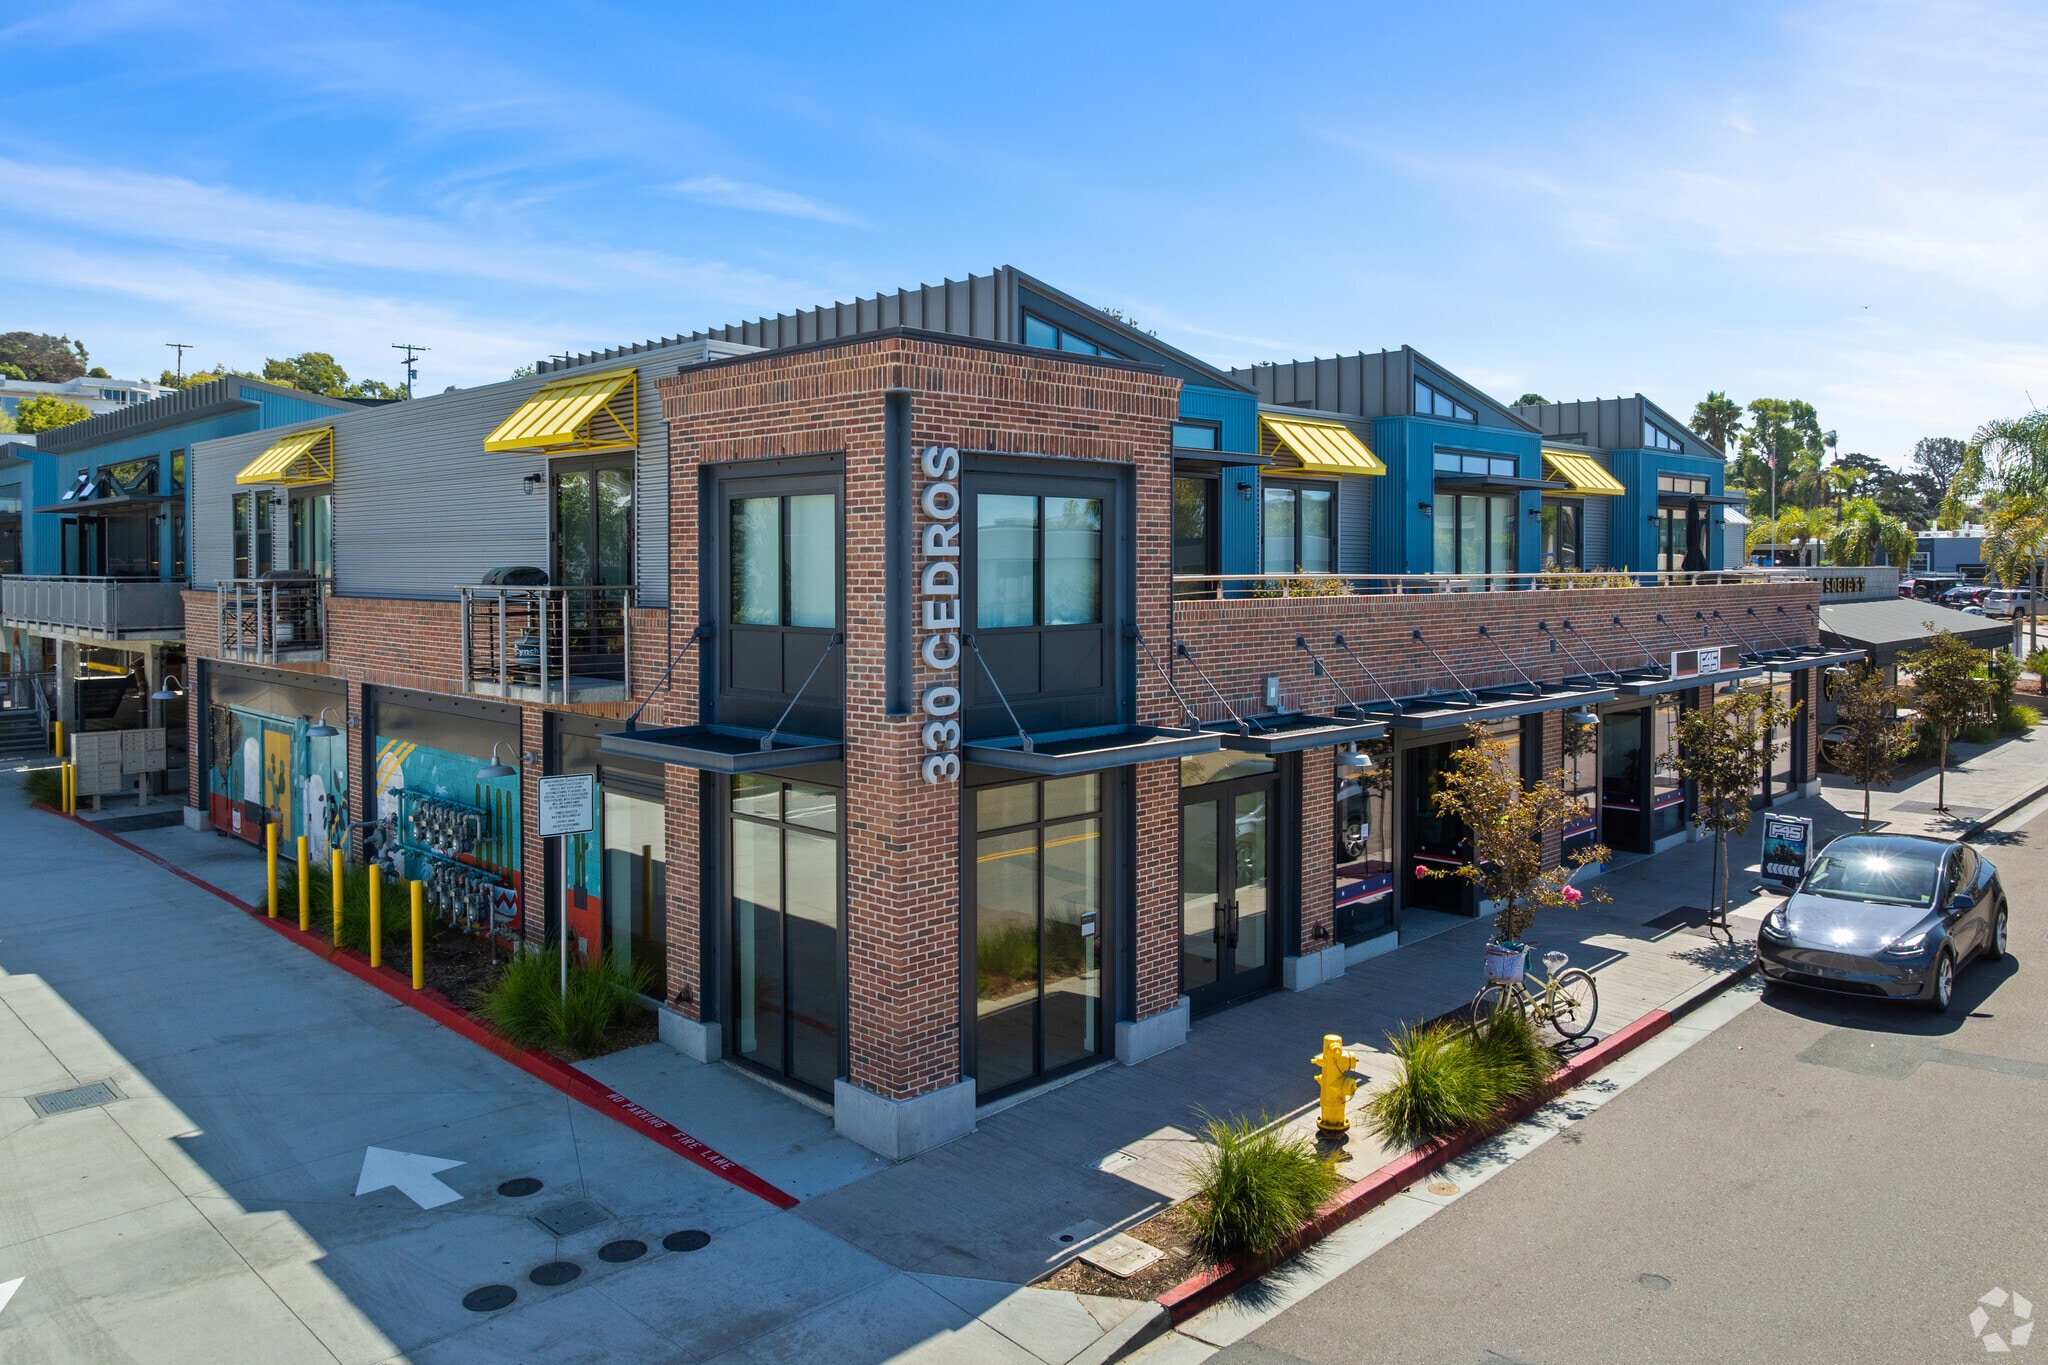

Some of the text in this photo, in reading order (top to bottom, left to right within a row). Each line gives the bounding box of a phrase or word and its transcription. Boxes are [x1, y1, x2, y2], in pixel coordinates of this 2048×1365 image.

[1824, 577, 1866, 593] SOCIETY
[921, 446, 961, 785] 330 CEDROS
[1770, 823, 1803, 840] F45
[606, 1093, 735, 1170] NO PARKING FIRE LANE
